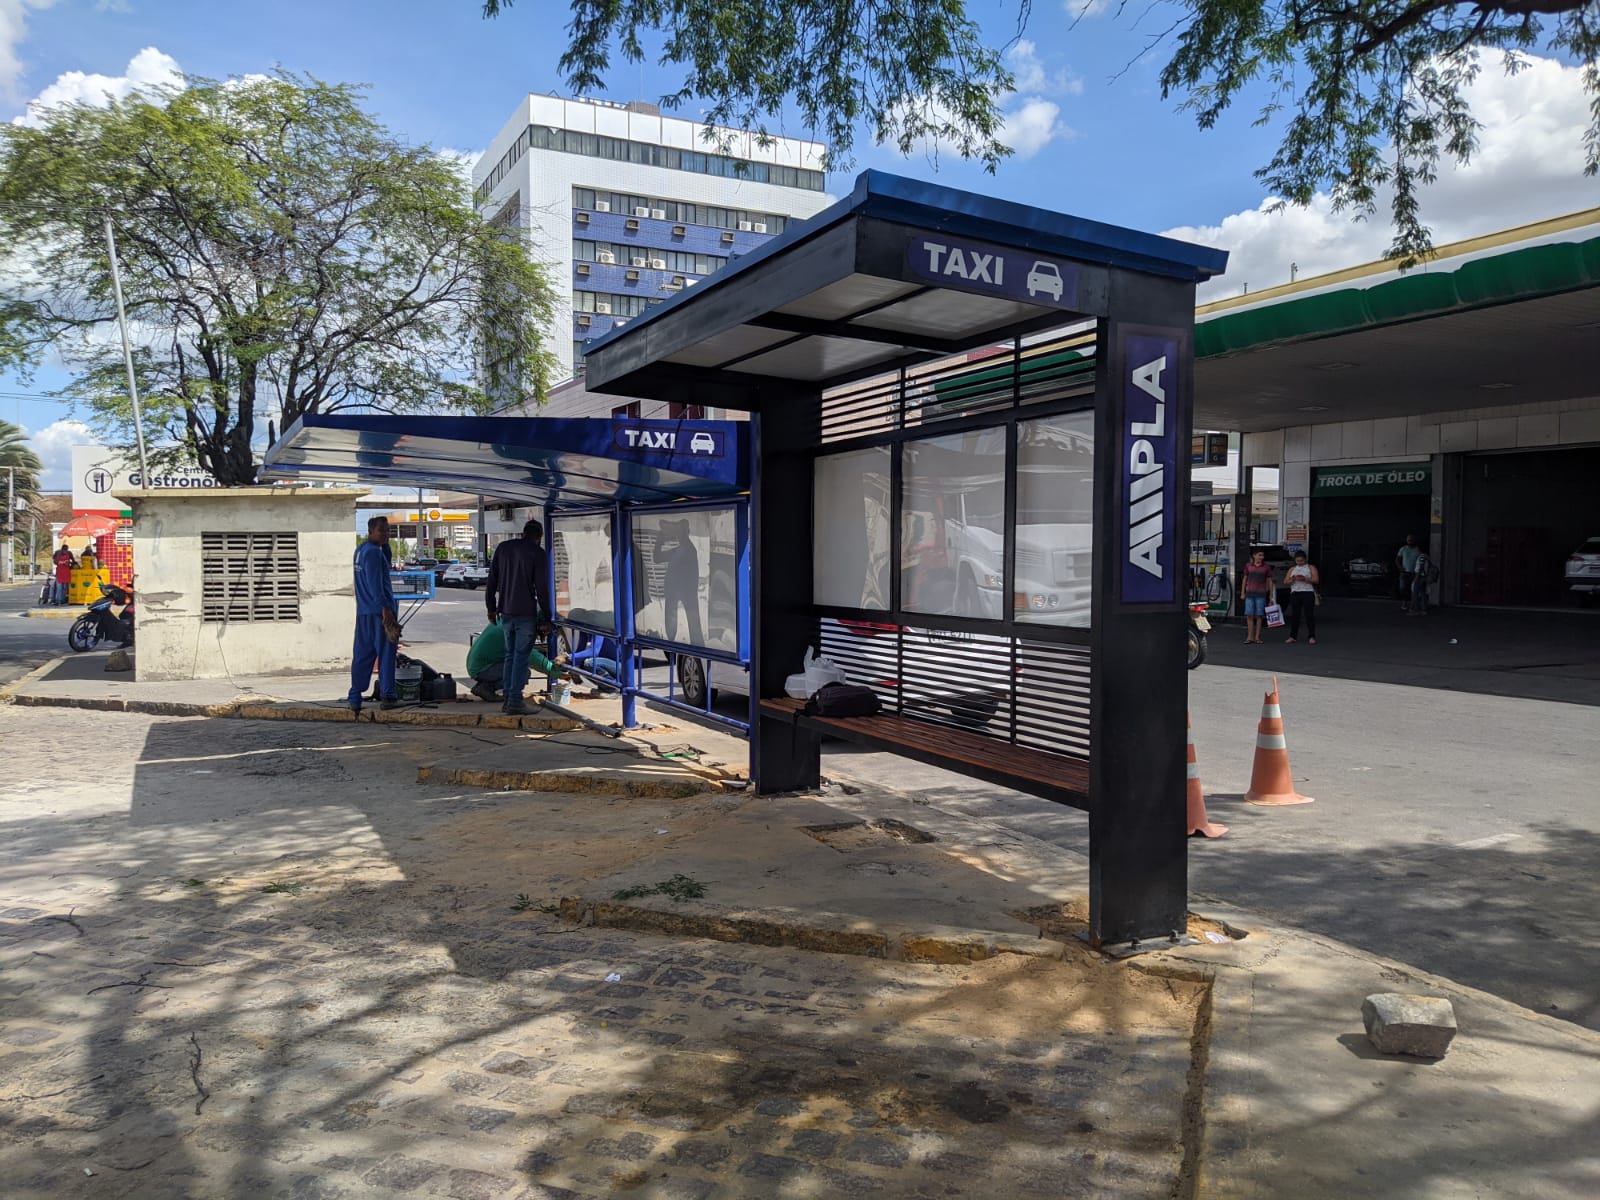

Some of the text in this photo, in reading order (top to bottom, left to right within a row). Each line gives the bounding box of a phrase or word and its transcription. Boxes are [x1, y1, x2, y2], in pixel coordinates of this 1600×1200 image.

[923, 241, 1004, 286] TAXI
[624, 429, 676, 449] TAXI
[1318, 470, 1425, 487] TROCA DE ÓLEO
